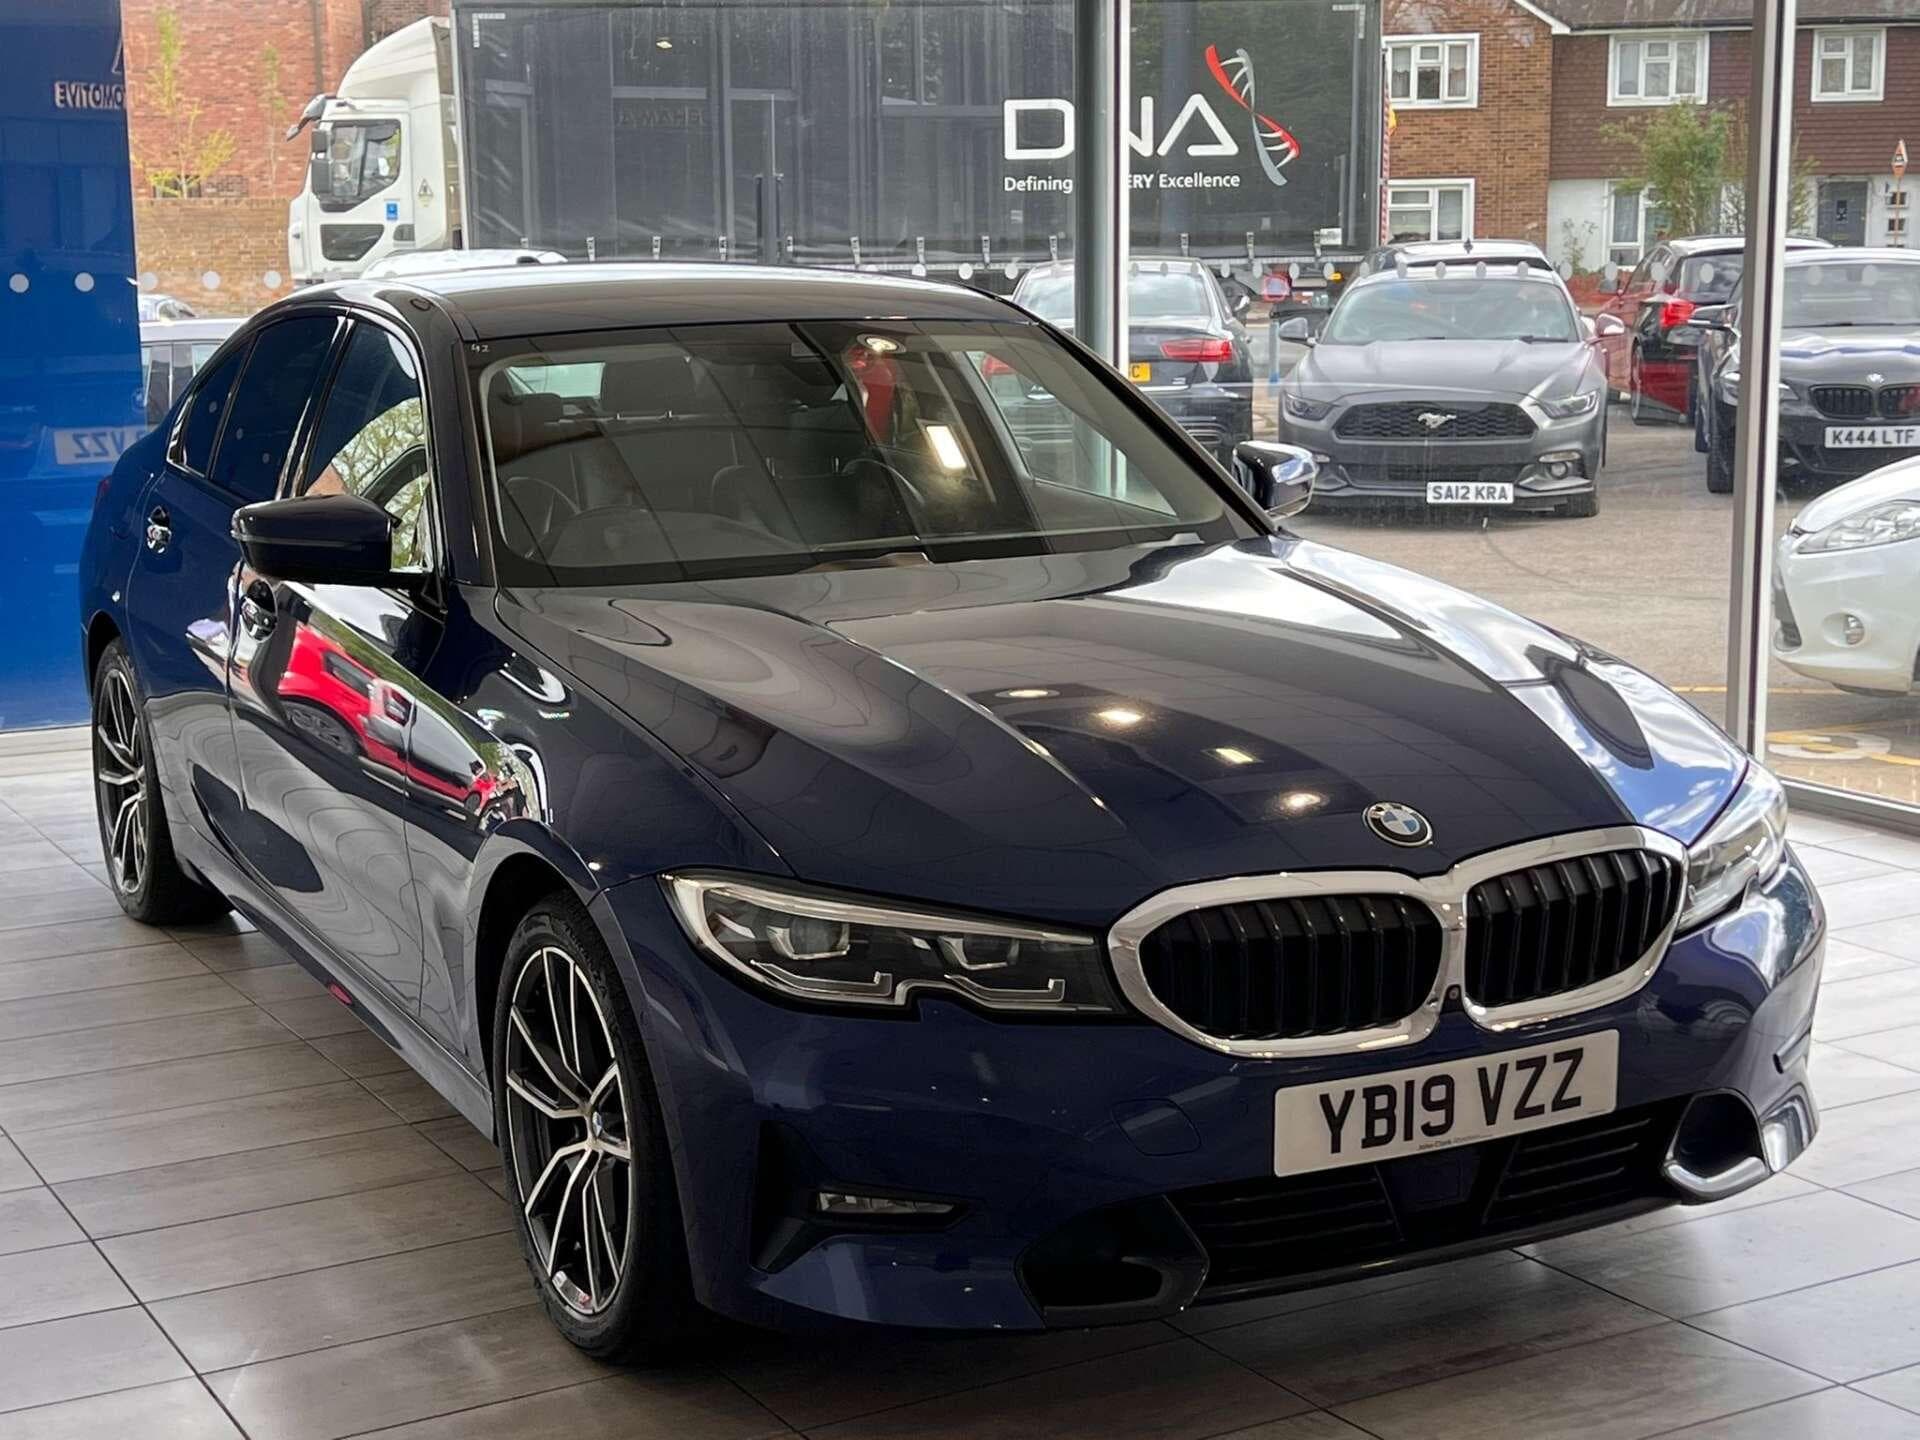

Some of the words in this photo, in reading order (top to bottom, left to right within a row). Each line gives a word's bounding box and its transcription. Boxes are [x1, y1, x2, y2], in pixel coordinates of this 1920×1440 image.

[1004, 176, 1073, 194] Defining
[1159, 172, 1240, 188] Excellence
[1832, 430, 1876, 445] K444
[1882, 429, 1915, 444] LTF
[1432, 485, 1470, 500] SA12
[1475, 485, 1508, 500] KRA
[1319, 1074, 1455, 1154] YB19
[1477, 1047, 1584, 1126] VZZ
